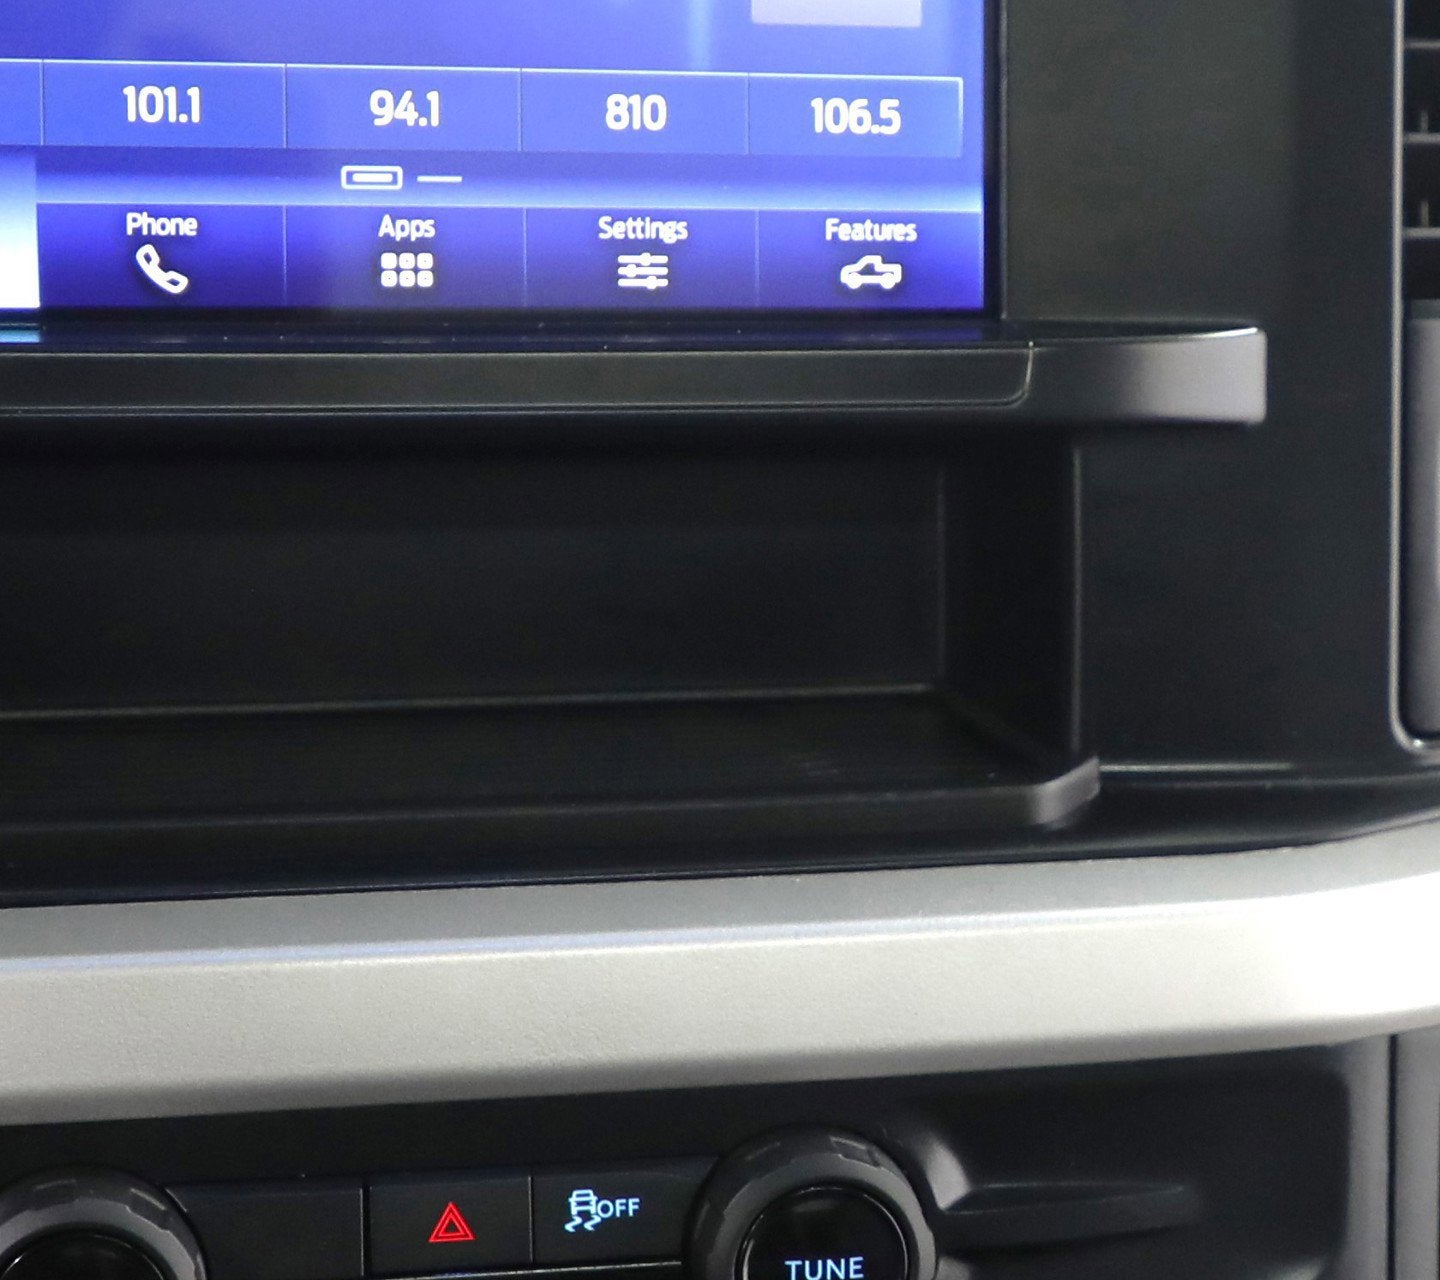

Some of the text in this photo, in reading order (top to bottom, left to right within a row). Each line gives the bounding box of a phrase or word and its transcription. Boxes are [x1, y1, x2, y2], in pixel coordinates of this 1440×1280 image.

[122, 85, 200, 123] 101.1
[369, 89, 440, 127] 94.1
[605, 93, 667, 132] 810
[810, 97, 902, 135] 106.5
[126, 211, 198, 237] Phone
[378, 214, 436, 242] Apps
[598, 215, 689, 244] Settings
[825, 217, 918, 242] Features
[597, 1197, 640, 1218] OFF
